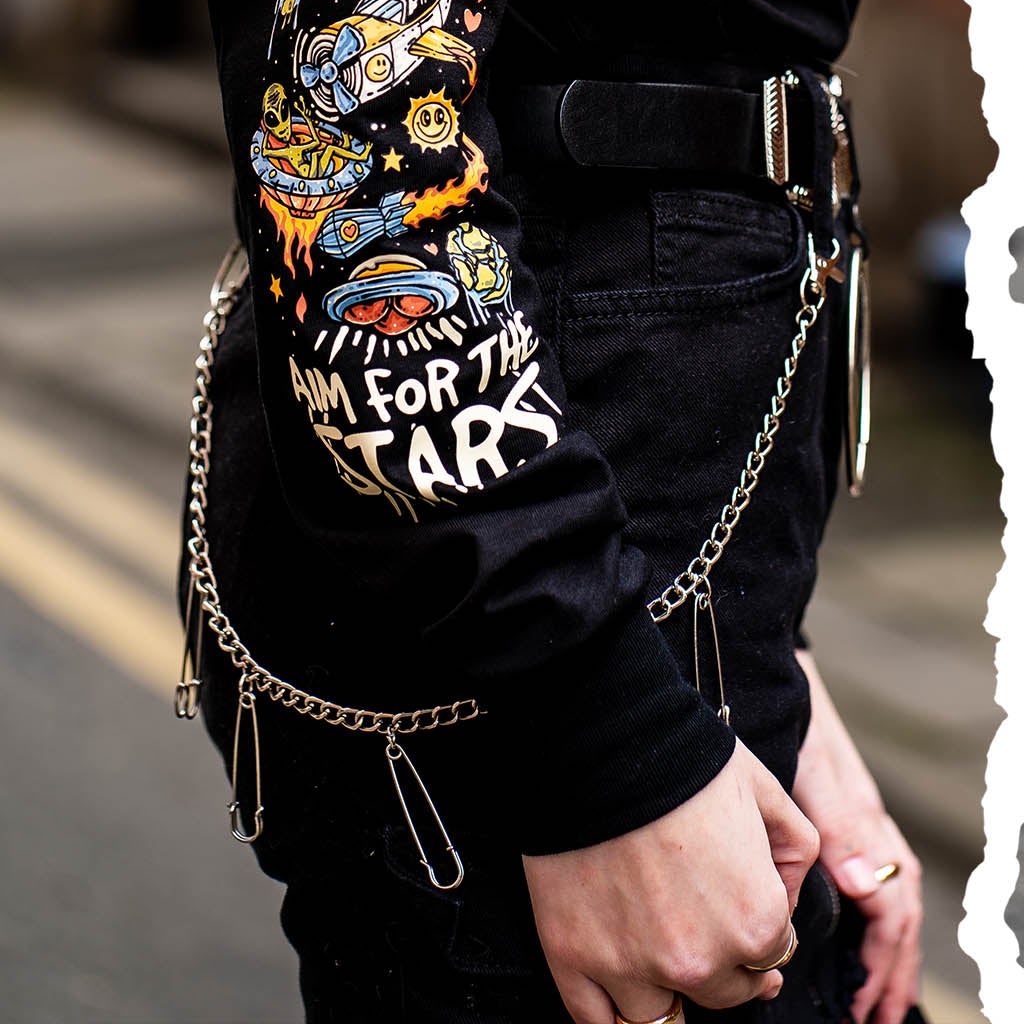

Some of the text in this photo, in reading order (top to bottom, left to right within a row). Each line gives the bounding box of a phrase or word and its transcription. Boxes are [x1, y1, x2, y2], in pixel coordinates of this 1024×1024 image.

[289, 310, 539, 424] AIM FOR THE
[313, 361, 561, 504] STARS
